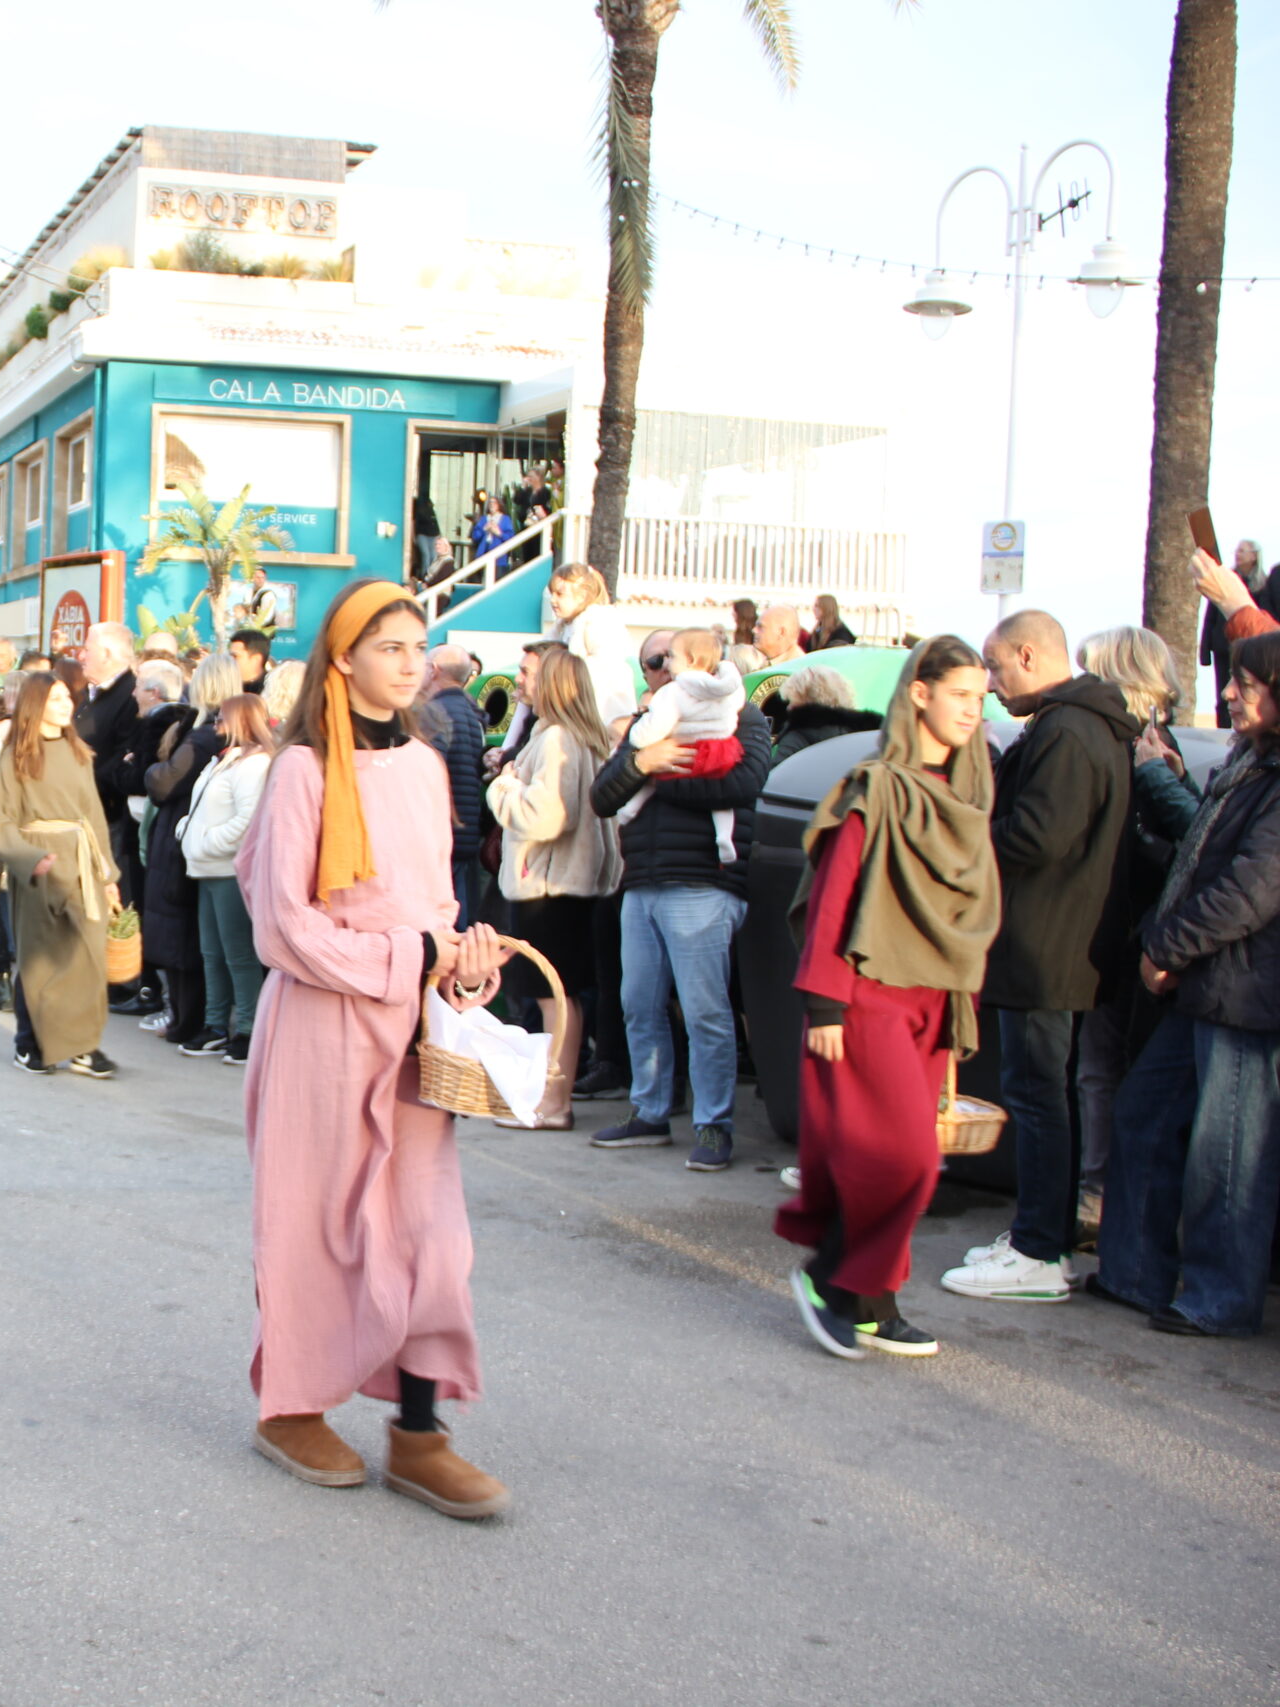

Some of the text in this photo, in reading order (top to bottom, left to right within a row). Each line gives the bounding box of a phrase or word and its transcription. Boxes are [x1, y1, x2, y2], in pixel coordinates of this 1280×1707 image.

[150, 186, 337, 232] ROOFTOP
[208, 377, 406, 410] CALA BANDIDA
[270, 511, 317, 525] SERVICE
